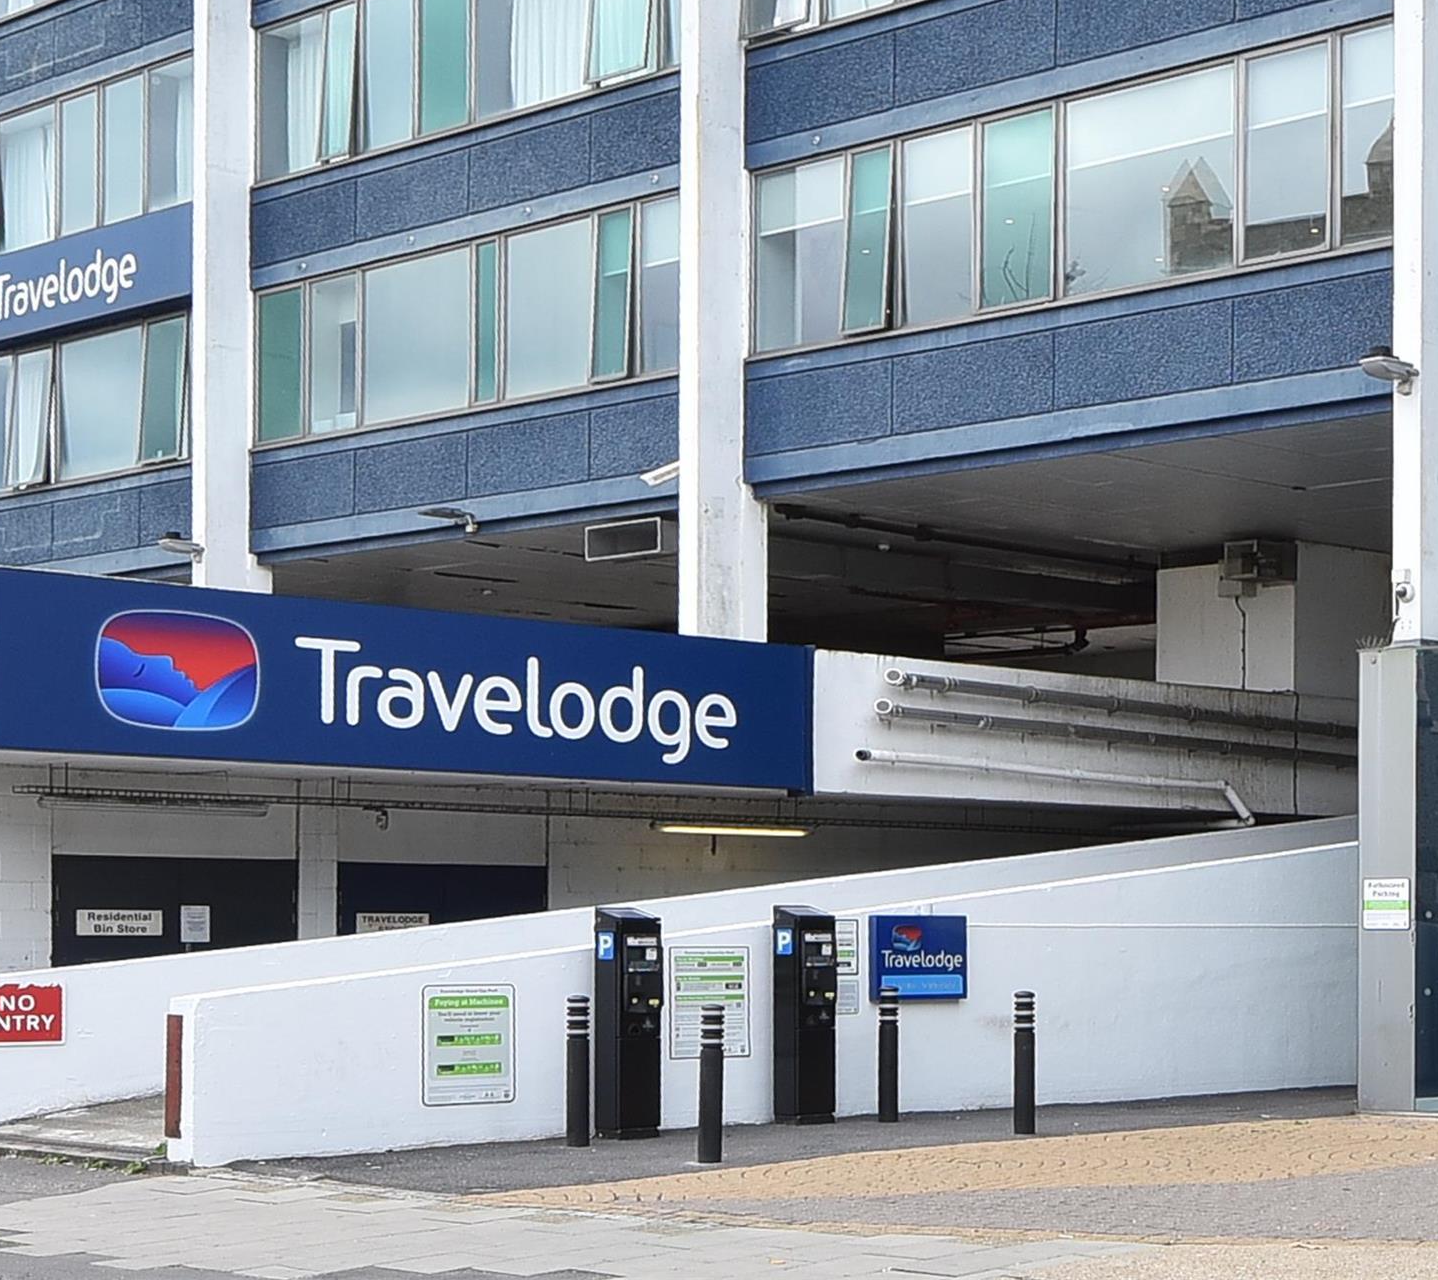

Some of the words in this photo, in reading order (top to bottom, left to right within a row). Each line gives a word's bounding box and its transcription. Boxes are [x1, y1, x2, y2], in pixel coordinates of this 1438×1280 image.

[294, 636, 737, 765] Travelodge
[87, 912, 152, 921] Residential
[362, 915, 425, 924] TRAVELODGE
[93, 924, 114, 933] Bin
[117, 924, 147, 933] Store
[600, 935, 611, 956] P
[778, 931, 790, 951] P
[881, 949, 963, 972] Travelodge
[0, 994, 35, 1011] NO
